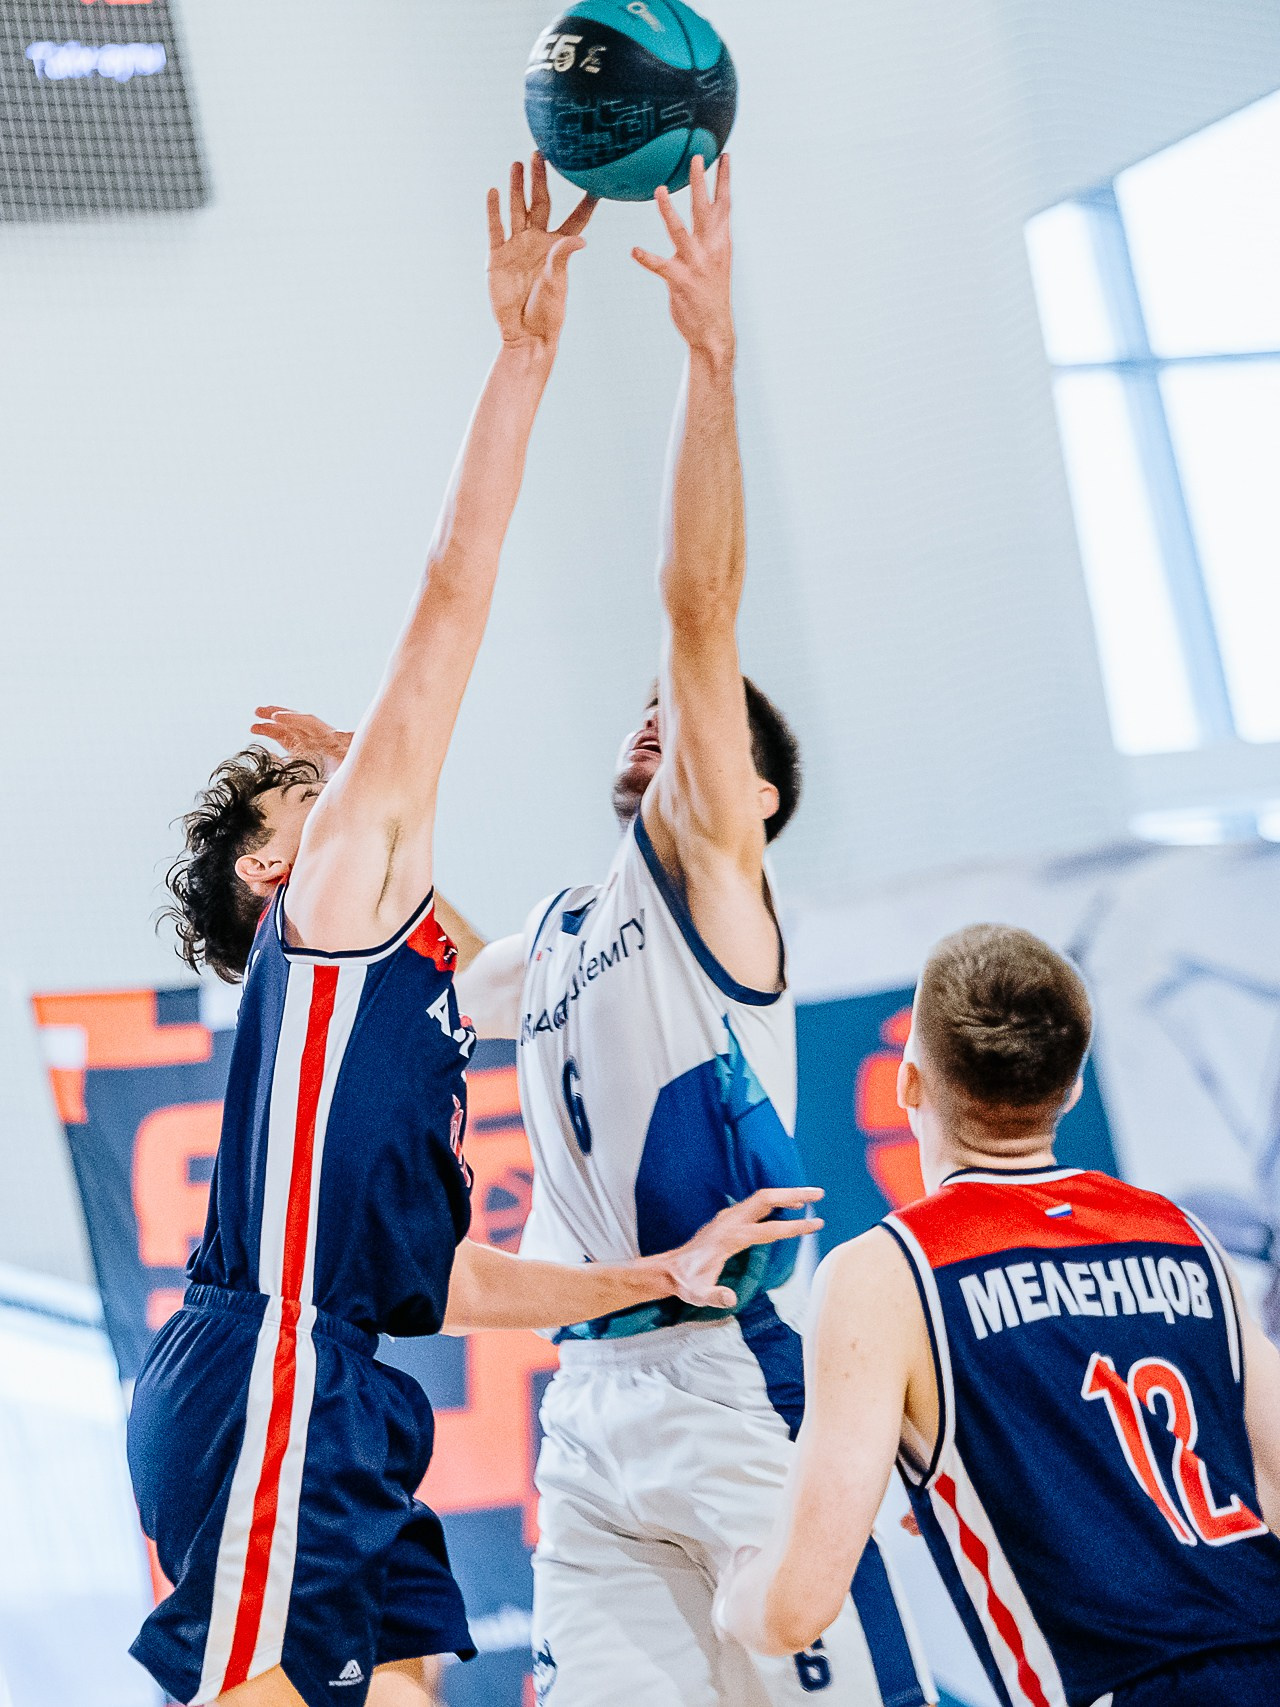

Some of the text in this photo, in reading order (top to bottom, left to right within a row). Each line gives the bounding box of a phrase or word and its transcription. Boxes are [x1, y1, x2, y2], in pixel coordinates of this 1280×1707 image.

[562, 1055, 592, 1157] 6
[958, 1256, 1214, 1341] МЕЛЕНЦОВ
[1081, 1351, 1270, 1547] 12
[793, 1637, 832, 1693] 6
